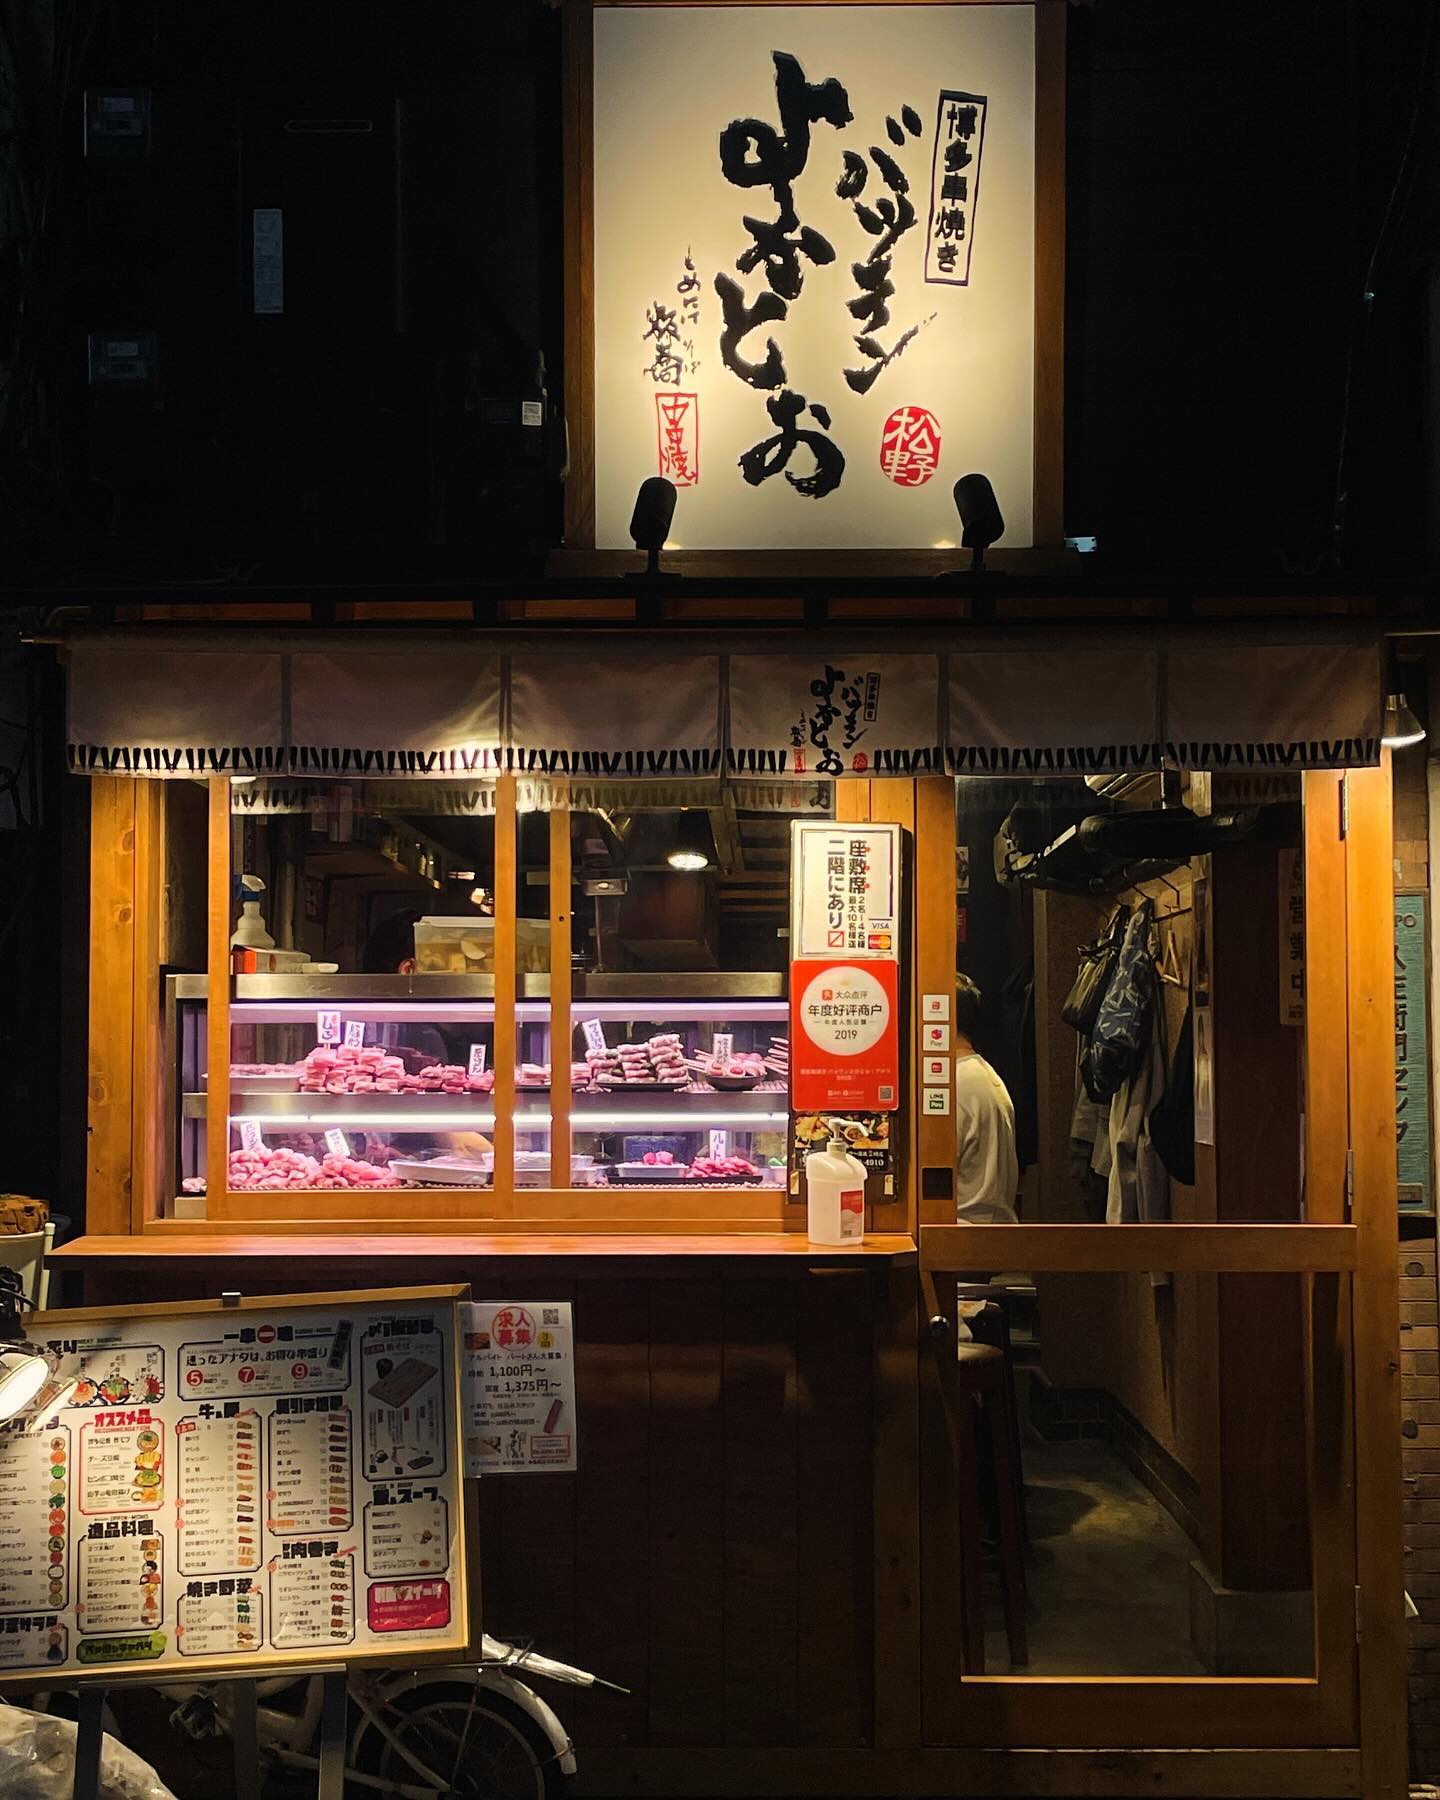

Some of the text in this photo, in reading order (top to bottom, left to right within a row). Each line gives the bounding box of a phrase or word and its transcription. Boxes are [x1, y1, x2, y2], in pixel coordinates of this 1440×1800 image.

[933, 103, 978, 274] 博多串焼き
[808, 1004, 883, 1018] 年度好评商户
[834, 1029, 858, 1040] 2019
[498, 1311, 531, 1328] 求人
[498, 1329, 533, 1346] 募集
